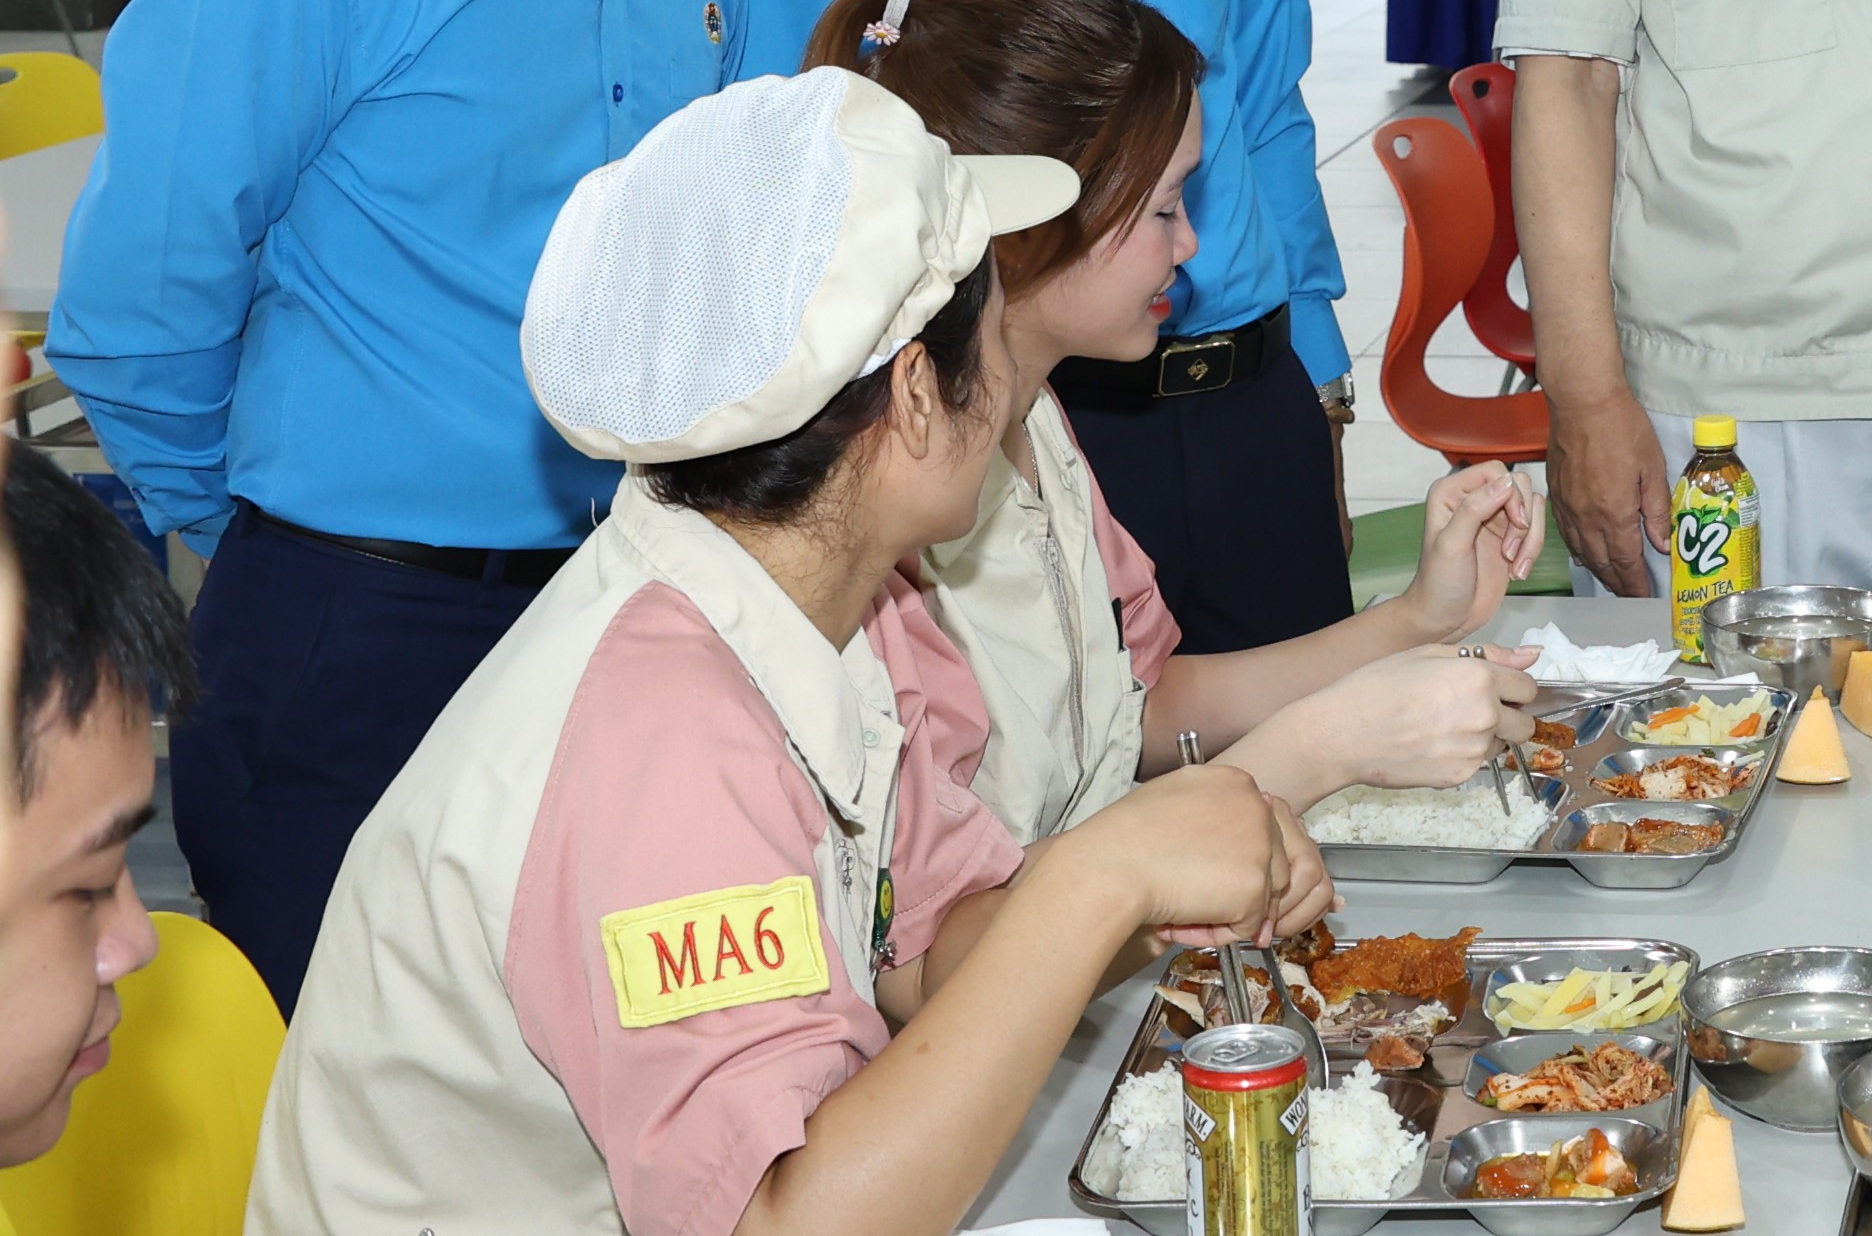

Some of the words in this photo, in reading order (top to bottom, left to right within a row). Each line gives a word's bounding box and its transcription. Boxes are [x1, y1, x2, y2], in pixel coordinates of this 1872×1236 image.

[1677, 513, 1731, 575] C2
[1677, 585, 1709, 603] LEMON
[1711, 579, 1734, 596] TEA
[646, 905, 786, 996] MA6
